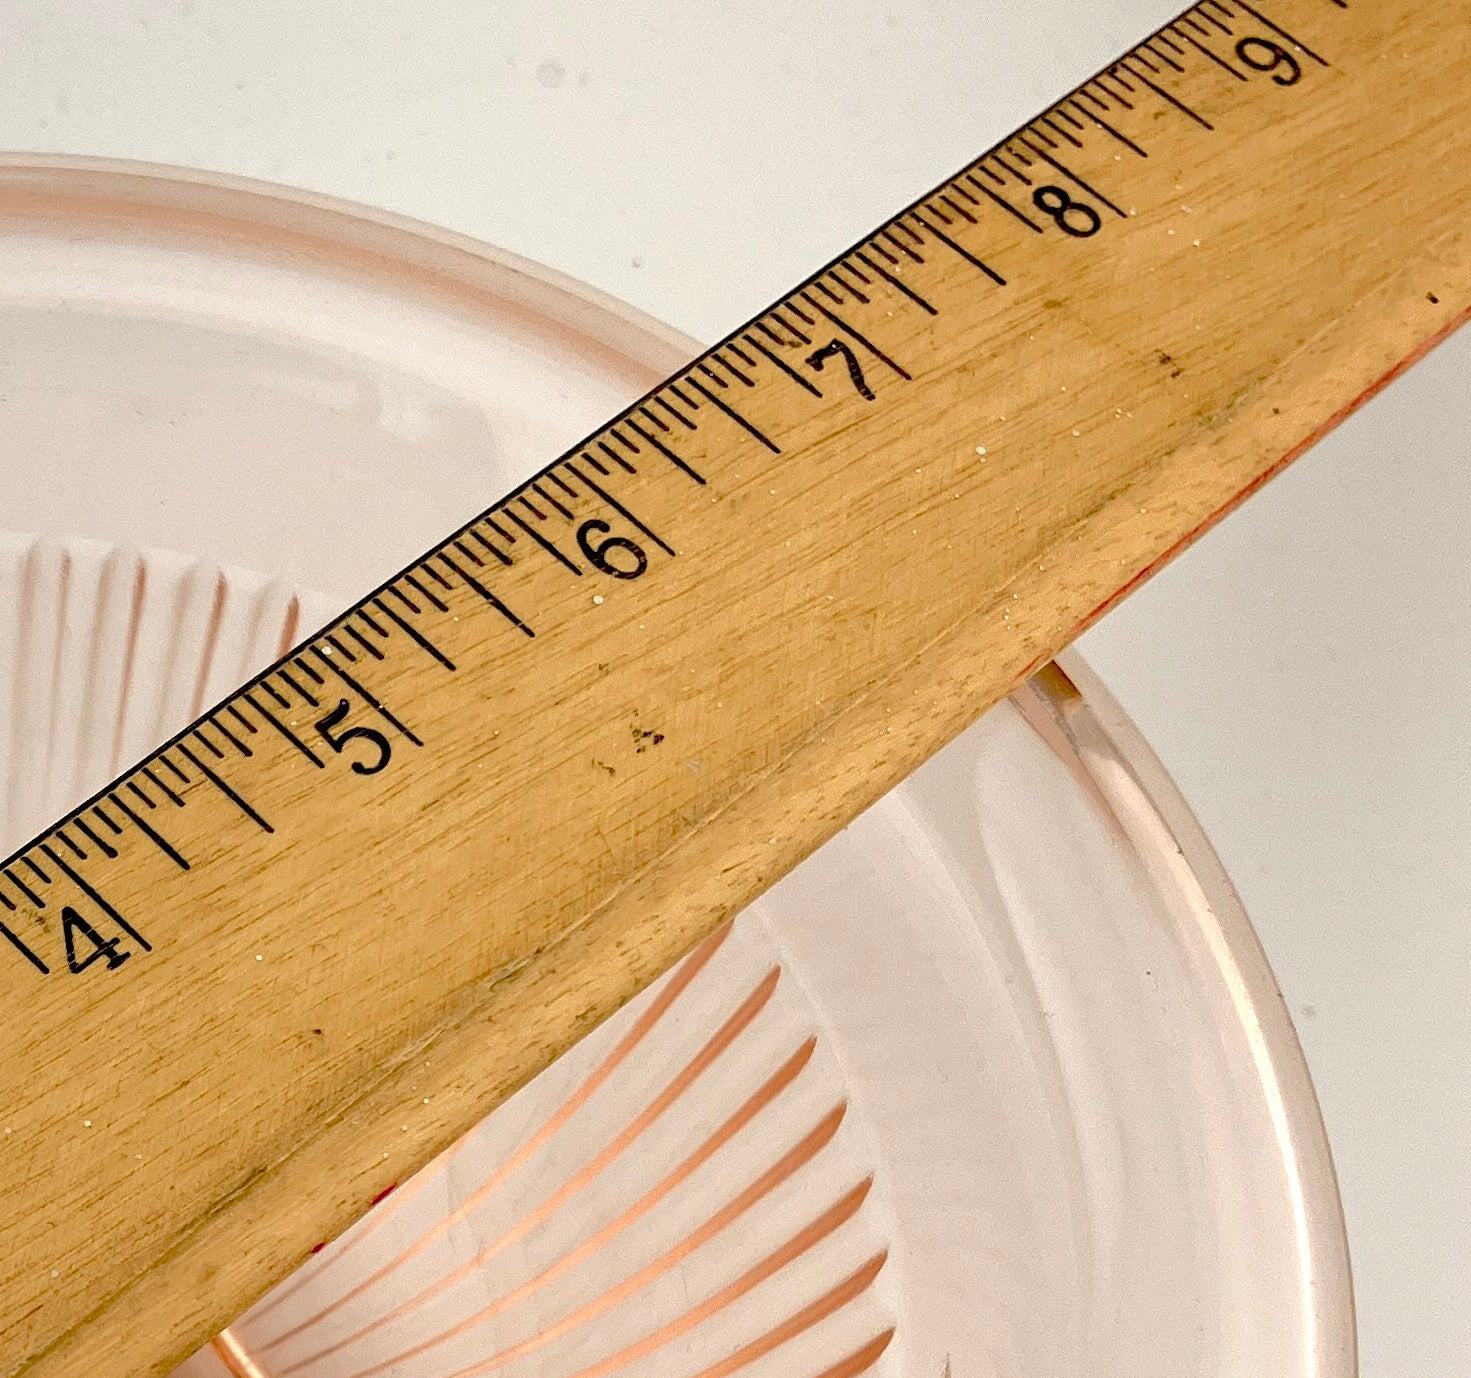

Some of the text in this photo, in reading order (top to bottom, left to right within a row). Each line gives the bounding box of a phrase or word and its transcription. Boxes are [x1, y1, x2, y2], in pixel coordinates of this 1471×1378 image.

[61, 906, 131, 974] 4
[314, 698, 392, 775] 5
[577, 518, 648, 580] 6
[805, 338, 876, 401] 7
[1032, 185, 1102, 238] 8
[1235, 37, 1302, 86] 9
